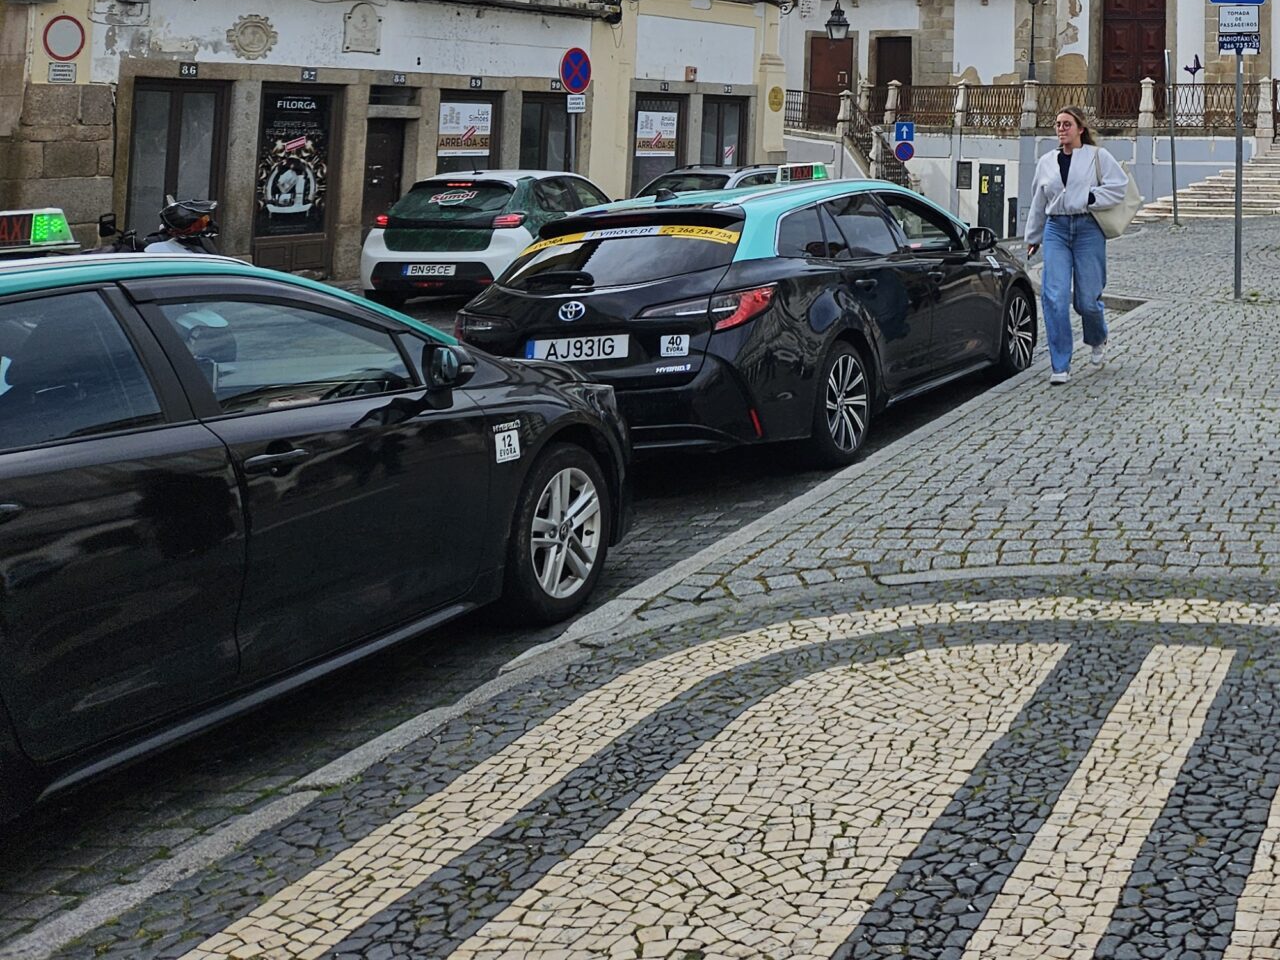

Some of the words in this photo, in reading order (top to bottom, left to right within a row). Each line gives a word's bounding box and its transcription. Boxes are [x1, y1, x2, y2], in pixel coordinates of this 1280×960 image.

[181, 65, 197, 75] 86
[393, 74, 405, 83] 88
[471, 79, 481, 87] 89
[551, 81, 561, 89] 90
[277, 100, 316, 110] FILORGA
[430, 190, 479, 203] Sumol
[695, 228, 714, 236] 734
[714, 231, 733, 239] 734
[668, 335, 682, 346] 40
[502, 434, 513, 448] 12
